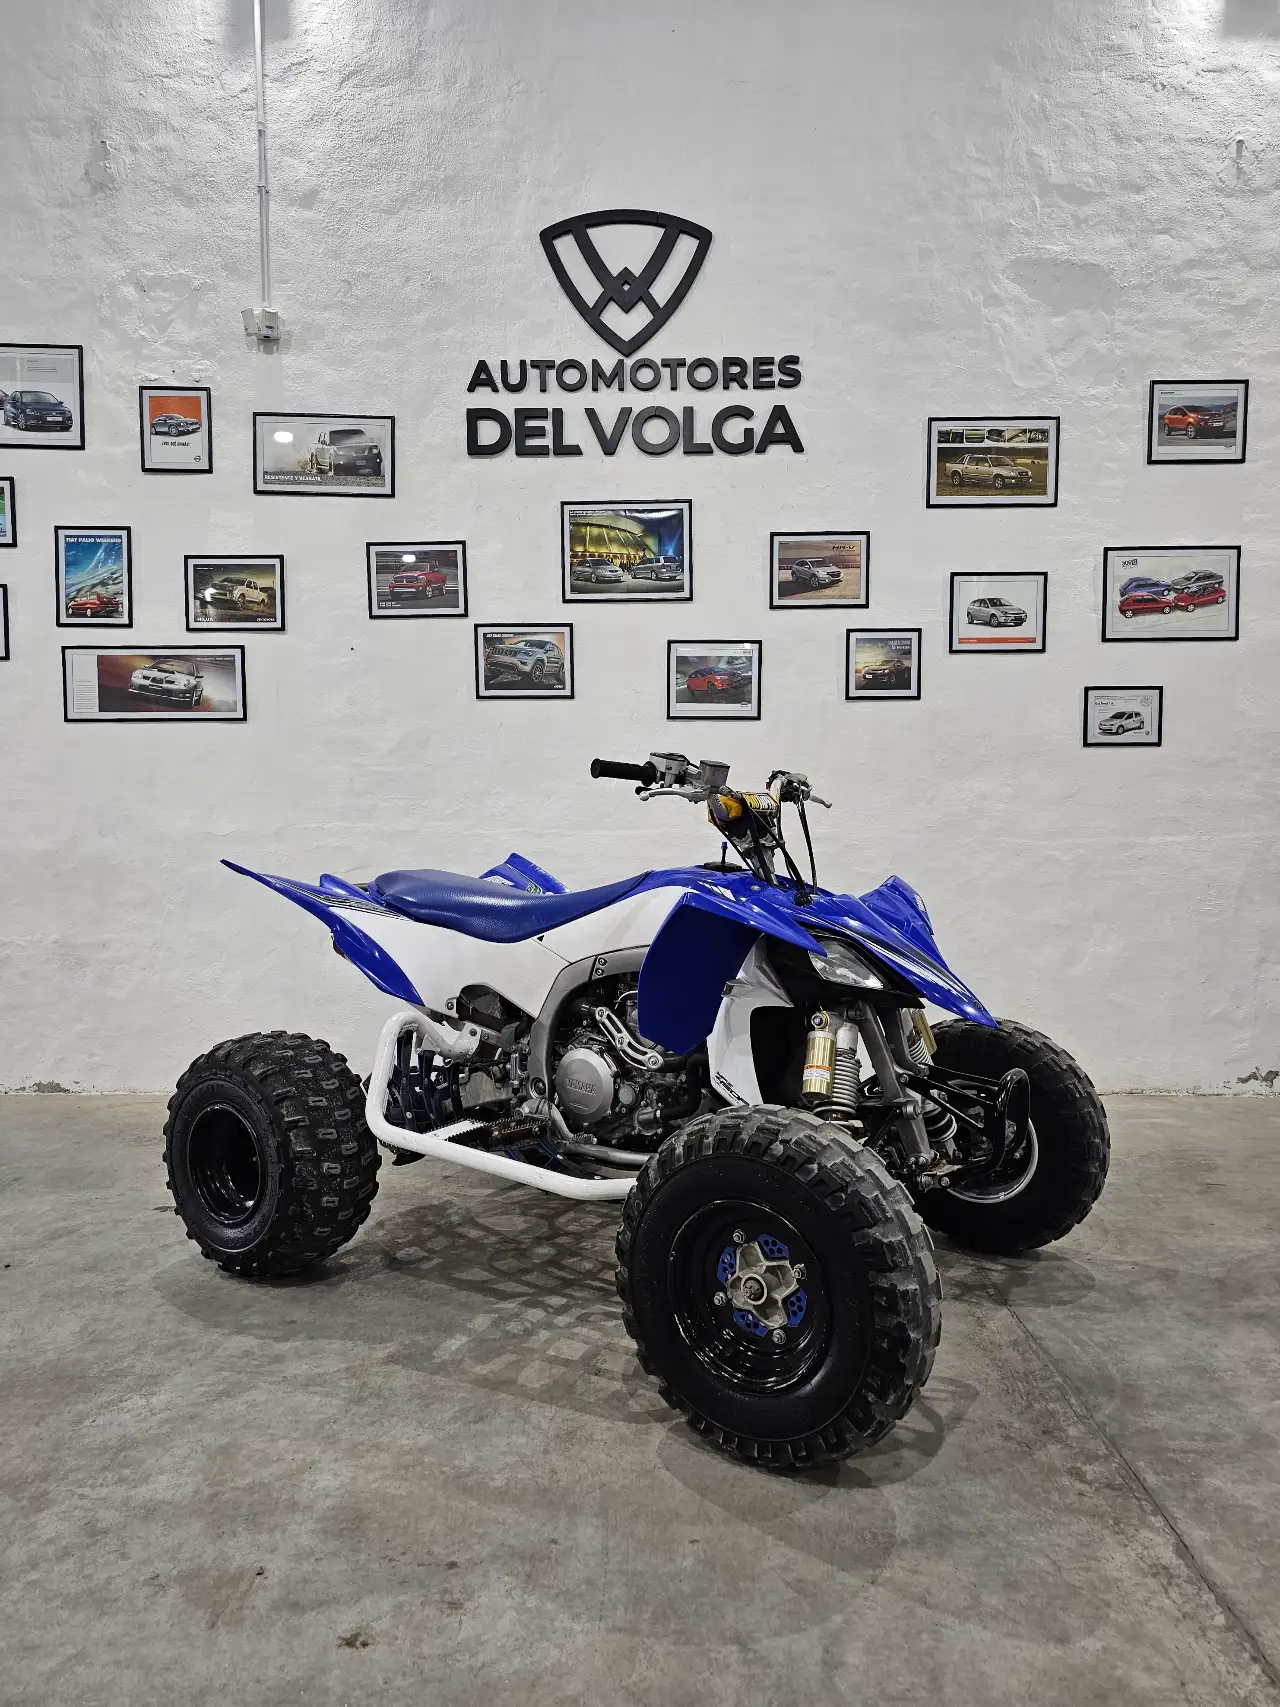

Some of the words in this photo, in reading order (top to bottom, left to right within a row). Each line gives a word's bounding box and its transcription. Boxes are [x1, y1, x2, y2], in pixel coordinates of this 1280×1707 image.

[467, 355, 802, 393] AUTOMOTORES
[466, 407, 583, 457] DEL
[584, 405, 804, 456] VOLGA
